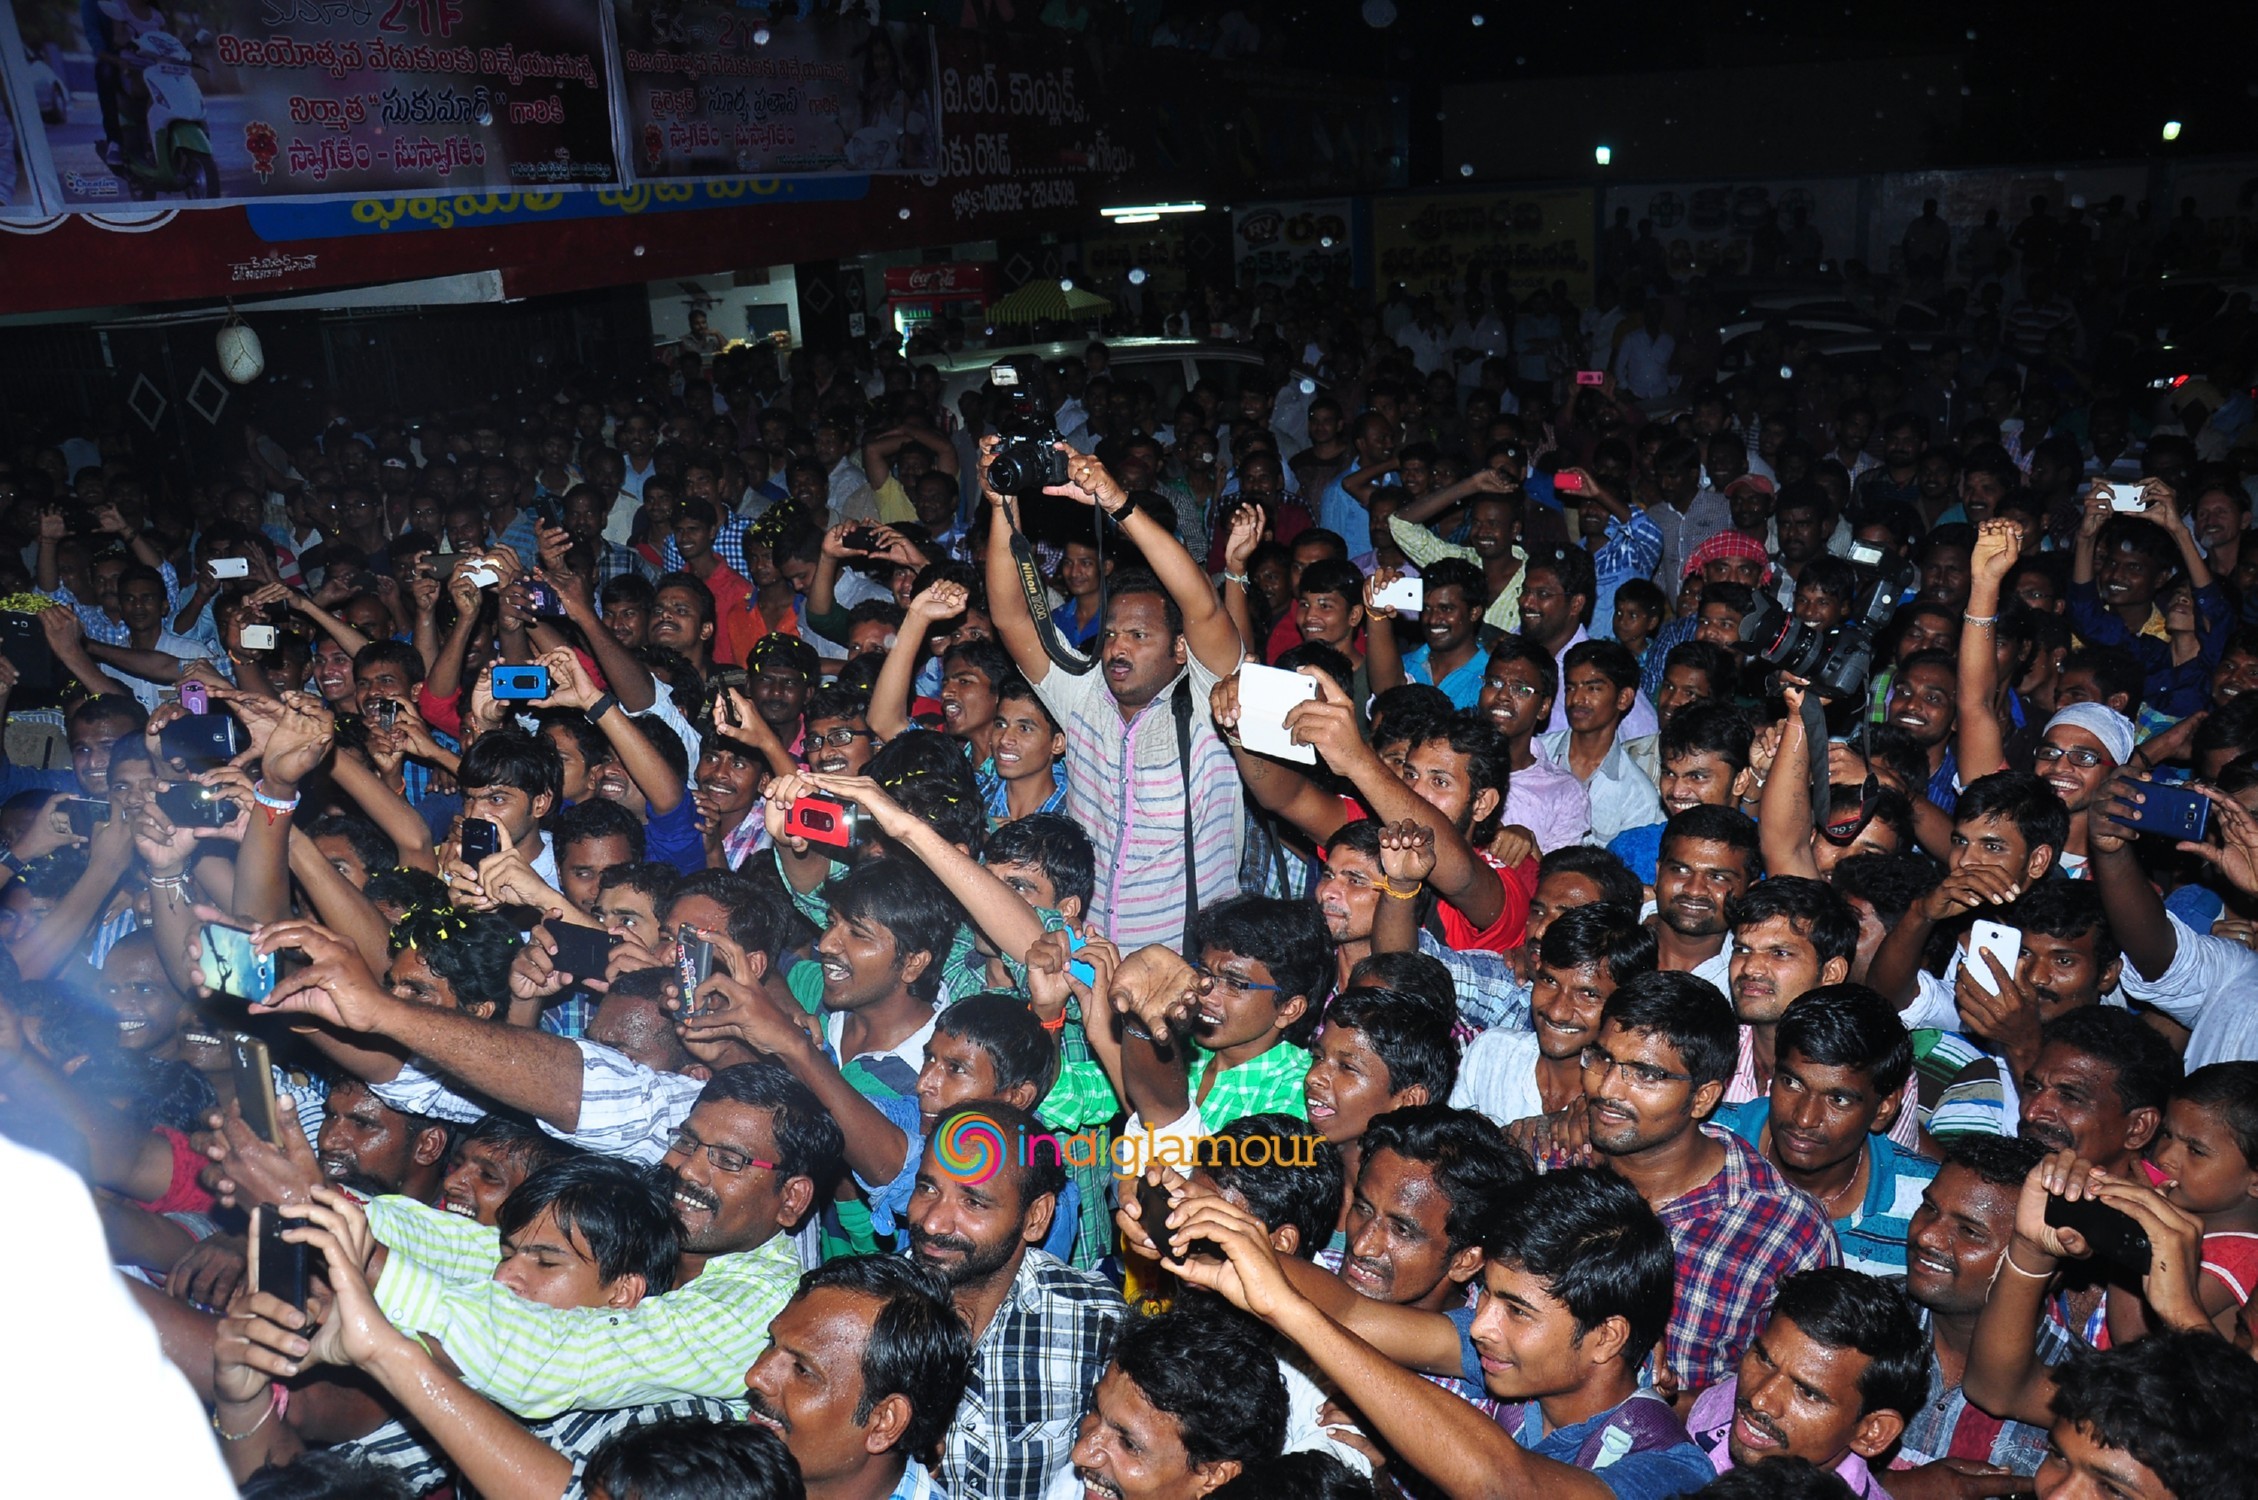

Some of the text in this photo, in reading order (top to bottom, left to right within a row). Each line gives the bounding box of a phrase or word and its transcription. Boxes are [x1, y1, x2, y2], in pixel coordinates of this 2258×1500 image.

[217, 35, 363, 78] విజయోత్సవ
[366, 36, 478, 74] వేడుకులకు
[289, 95, 366, 132] నిర్మాత
[288, 136, 371, 180] స్వాగతం
[1021, 562, 1038, 594] Nikon
